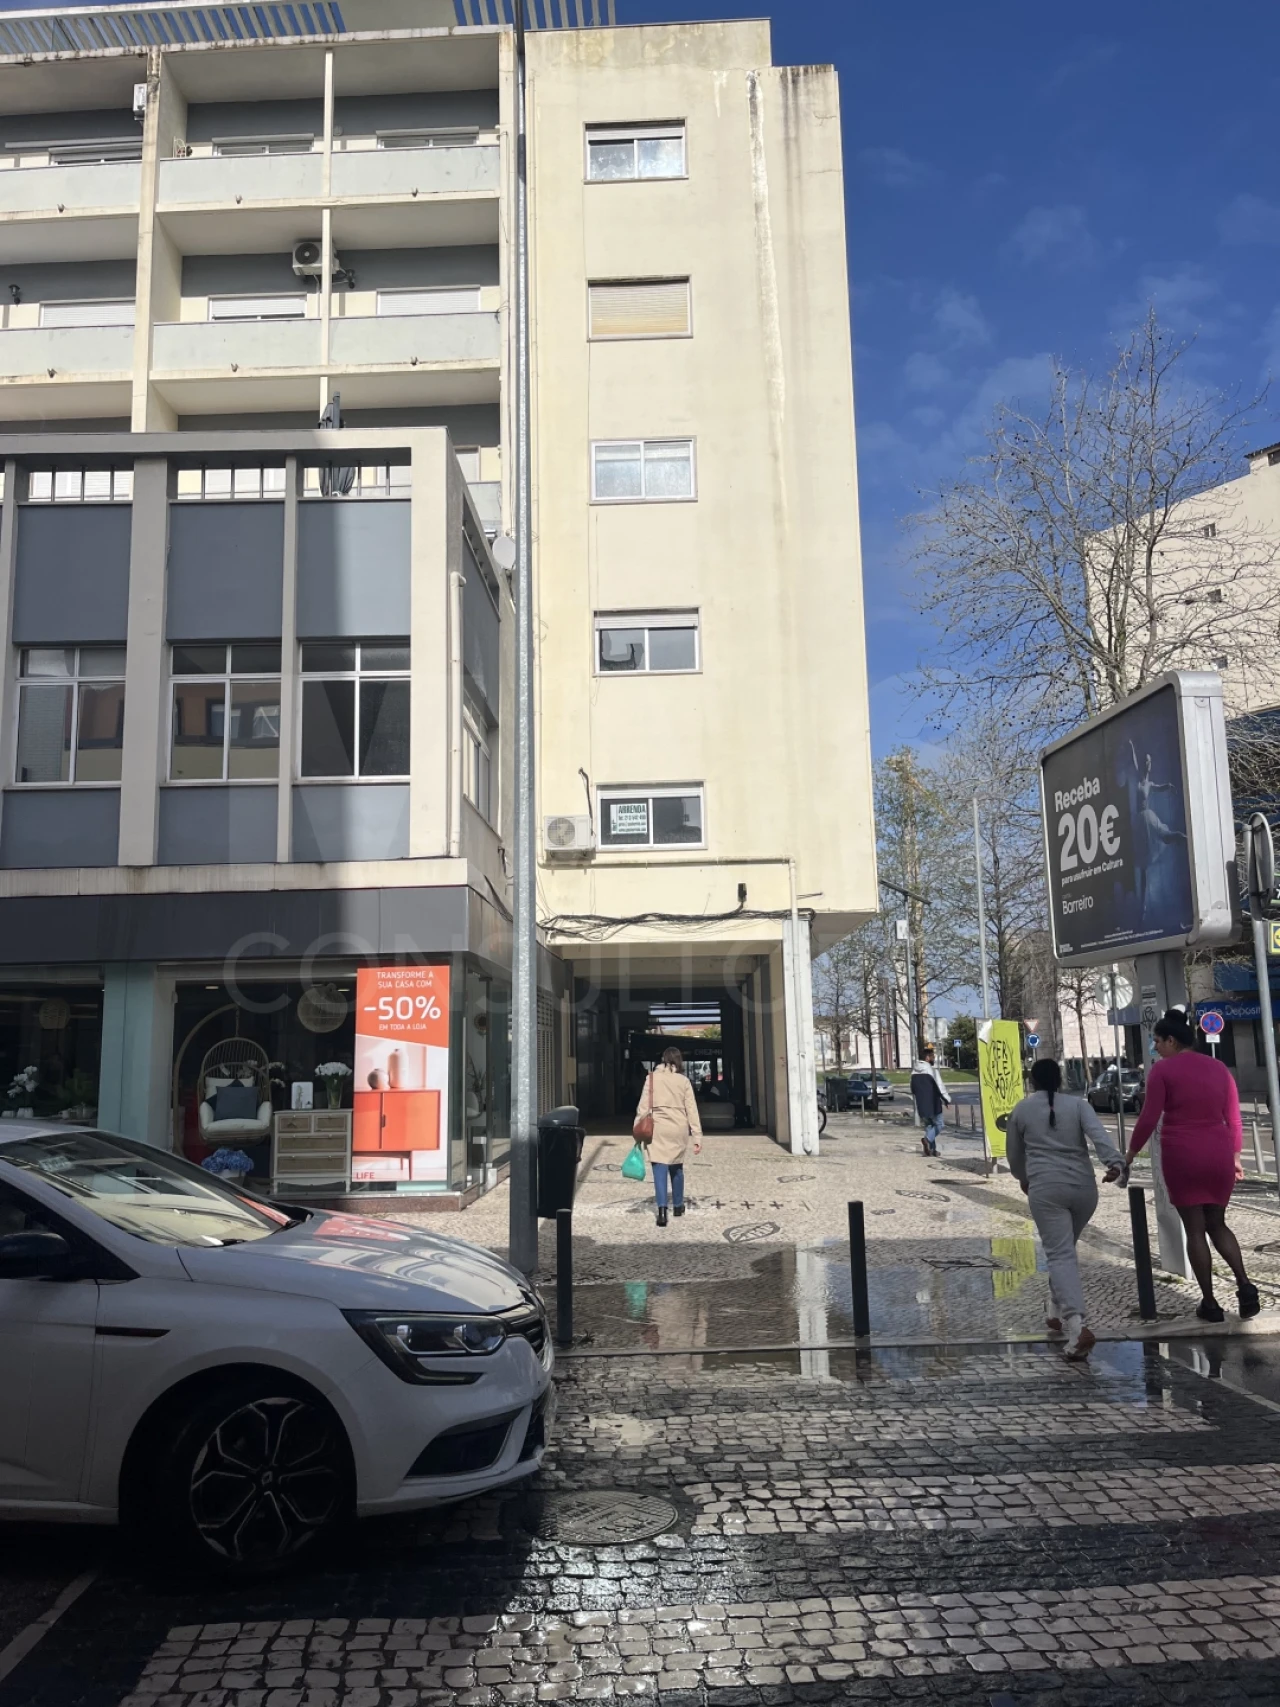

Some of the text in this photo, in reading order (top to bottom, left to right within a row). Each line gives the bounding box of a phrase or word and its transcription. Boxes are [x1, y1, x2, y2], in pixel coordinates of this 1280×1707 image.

[1054, 776, 1101, 812] Receba
[1057, 804, 1121, 872] 20€
[1062, 895, 1094, 915] Barreiro
[377, 970, 434, 979] TRANSFORME A
[364, 996, 442, 1020] -50%
[356, 1172, 376, 1180] LIFE
